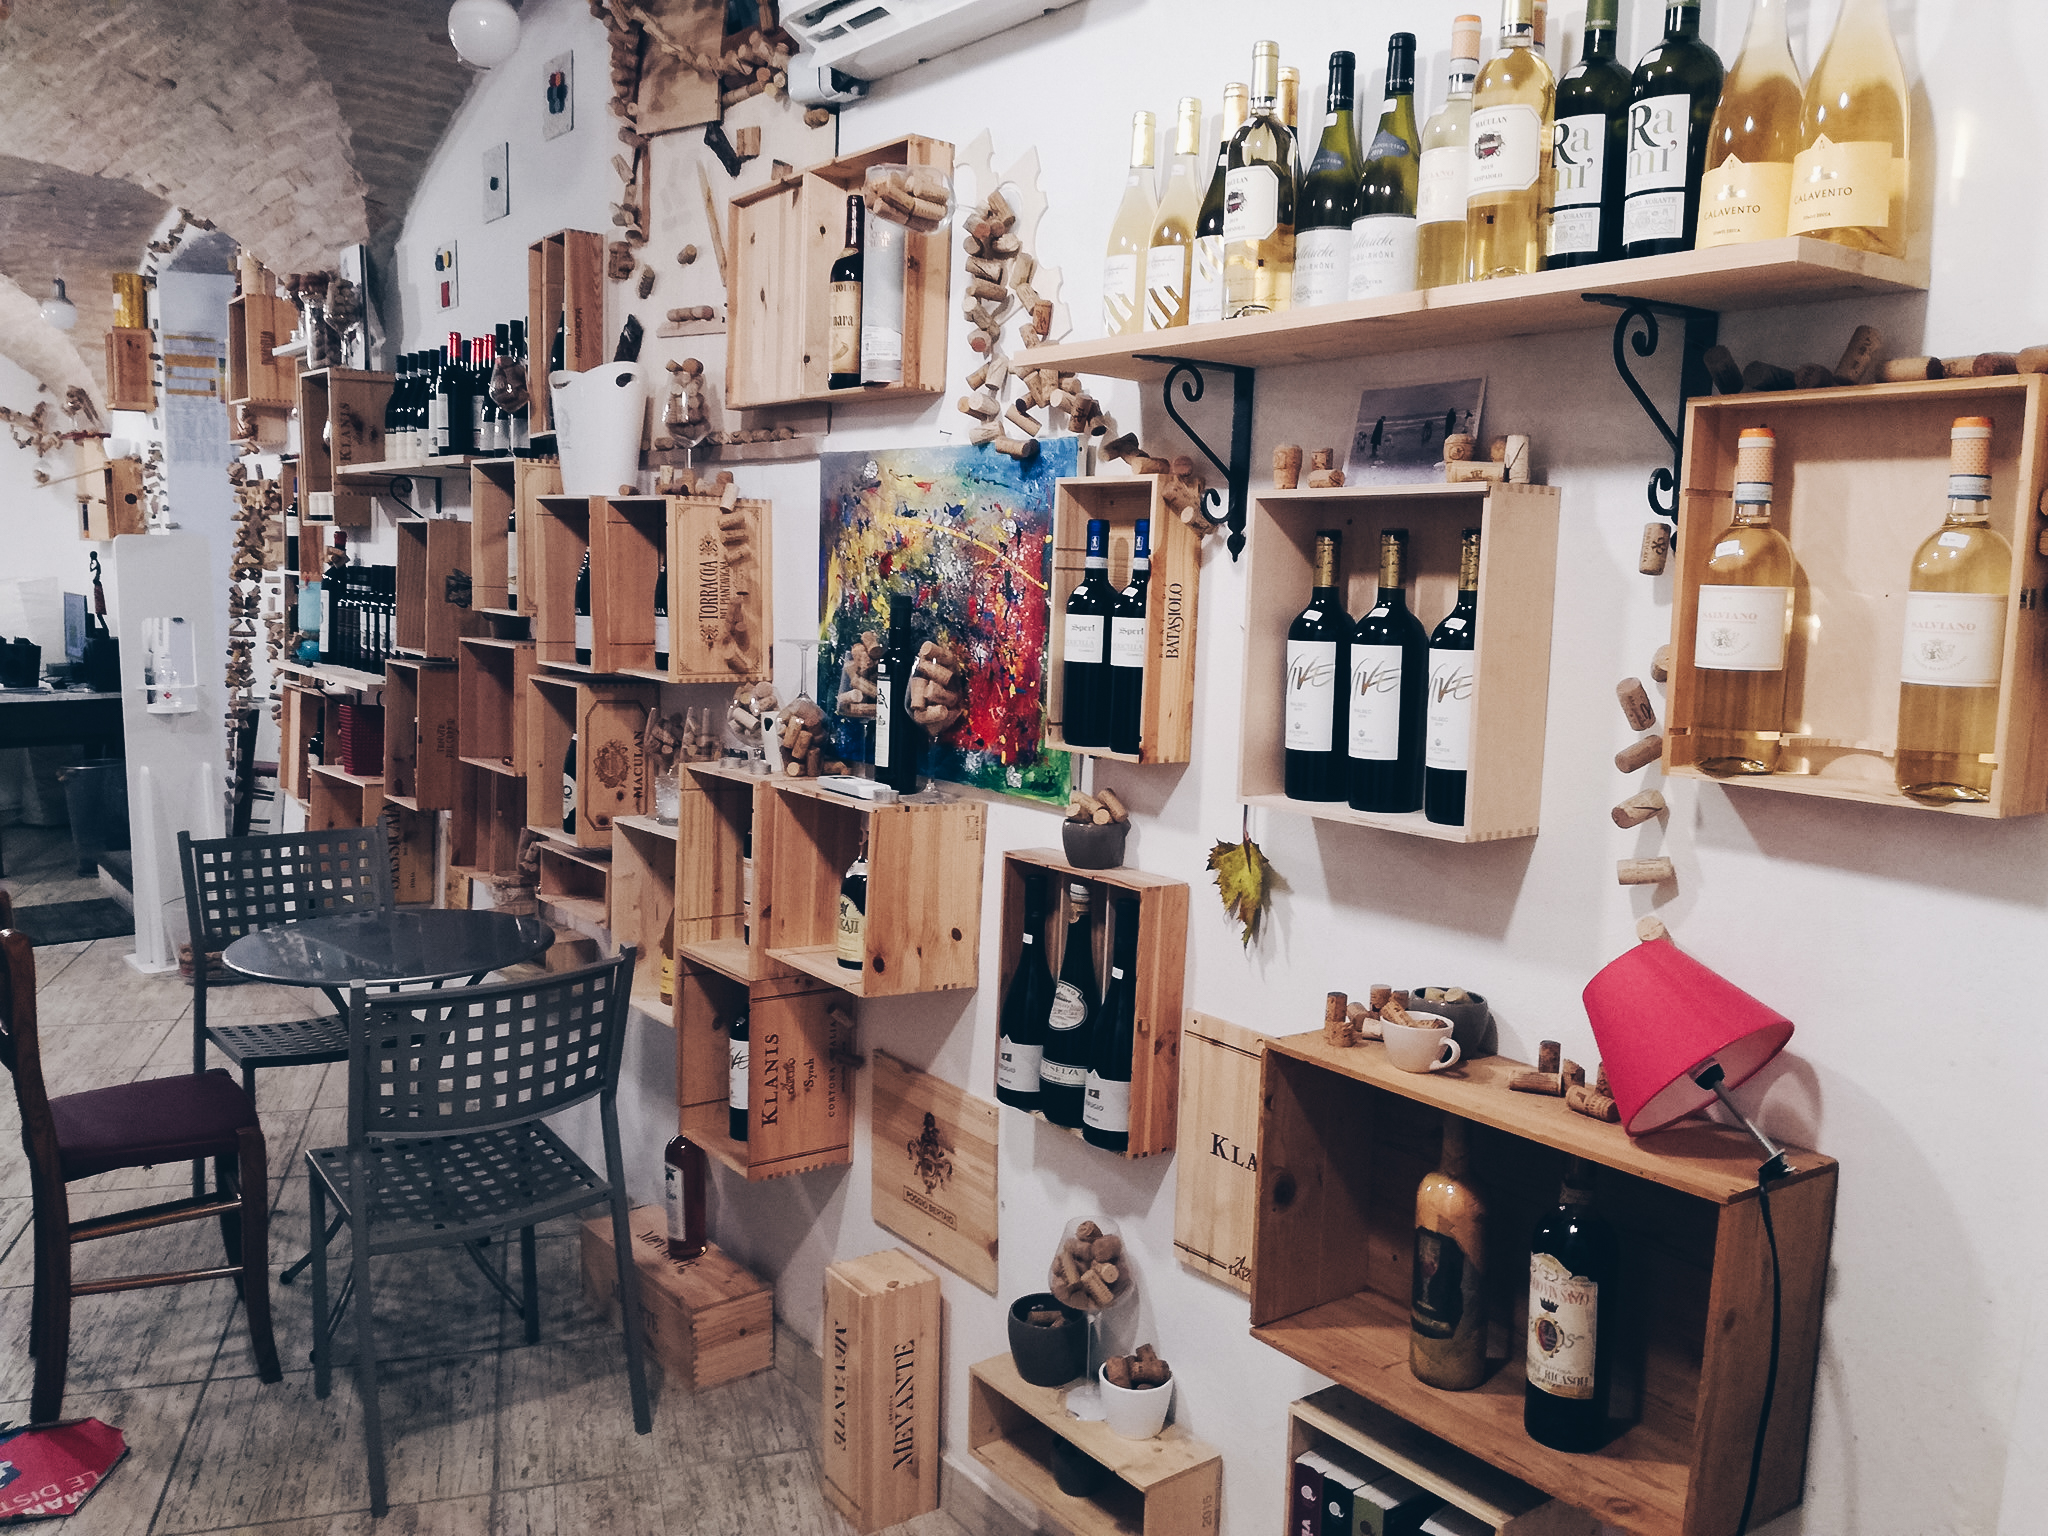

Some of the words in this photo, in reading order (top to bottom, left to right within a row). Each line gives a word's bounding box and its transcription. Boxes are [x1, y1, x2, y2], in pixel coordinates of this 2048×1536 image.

[1793, 186, 1853, 205] CALAVENTO
[1703, 204, 1761, 221] CALAVENTO
[1165, 582, 1187, 660] BATASIOLO
[1701, 610, 1758, 622] SALVIANO
[1911, 619, 1977, 632] SALVIANO
[761, 1033, 779, 1128] KLANIS
[803, 1057, 815, 1088] Syrah
